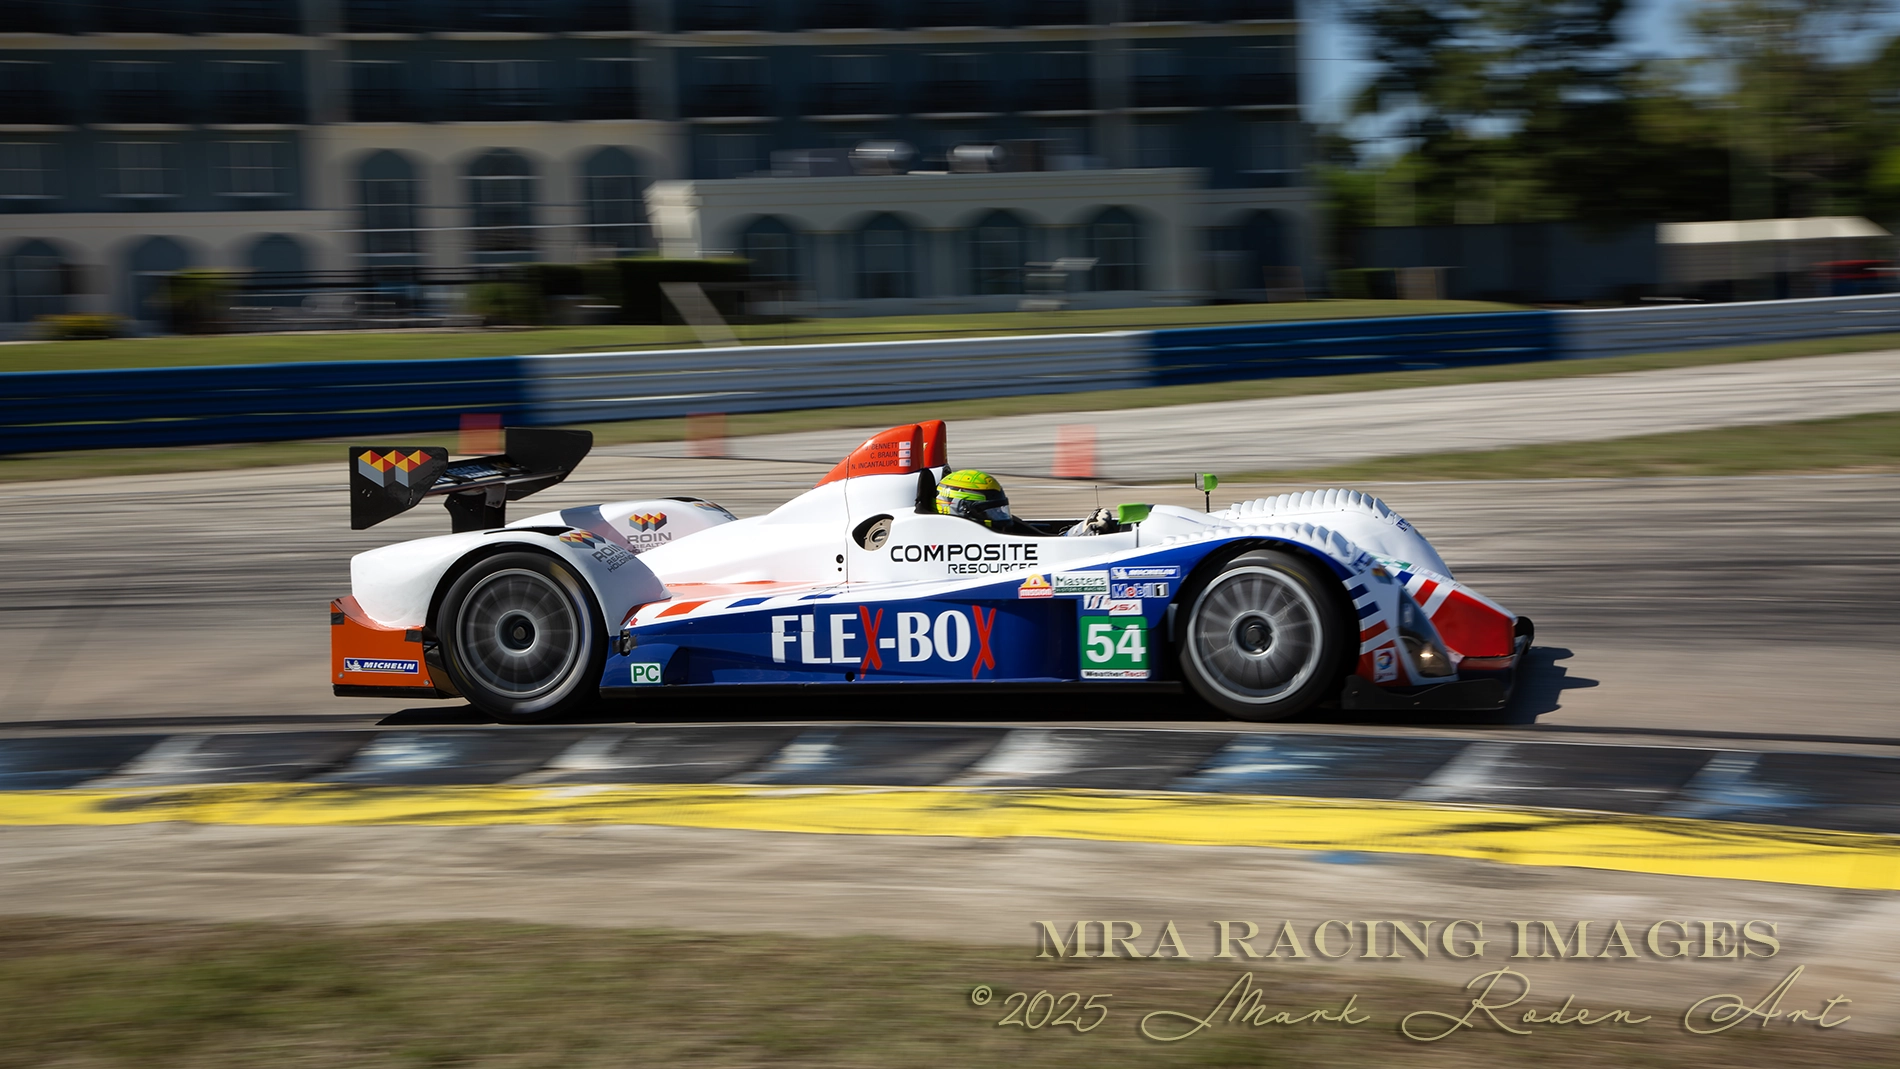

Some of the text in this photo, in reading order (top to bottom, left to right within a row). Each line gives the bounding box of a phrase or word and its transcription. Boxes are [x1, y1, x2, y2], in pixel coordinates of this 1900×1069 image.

[858, 460, 898, 469] INCANTALUPO
[627, 532, 672, 544] ROIN
[890, 543, 1038, 562] COMPOSITE
[1056, 576, 1105, 586] Masters
[771, 605, 997, 679] FLEX-BOX
[1086, 624, 1146, 662] 54
[363, 662, 415, 670] MICHELIN
[633, 664, 660, 682] PC
